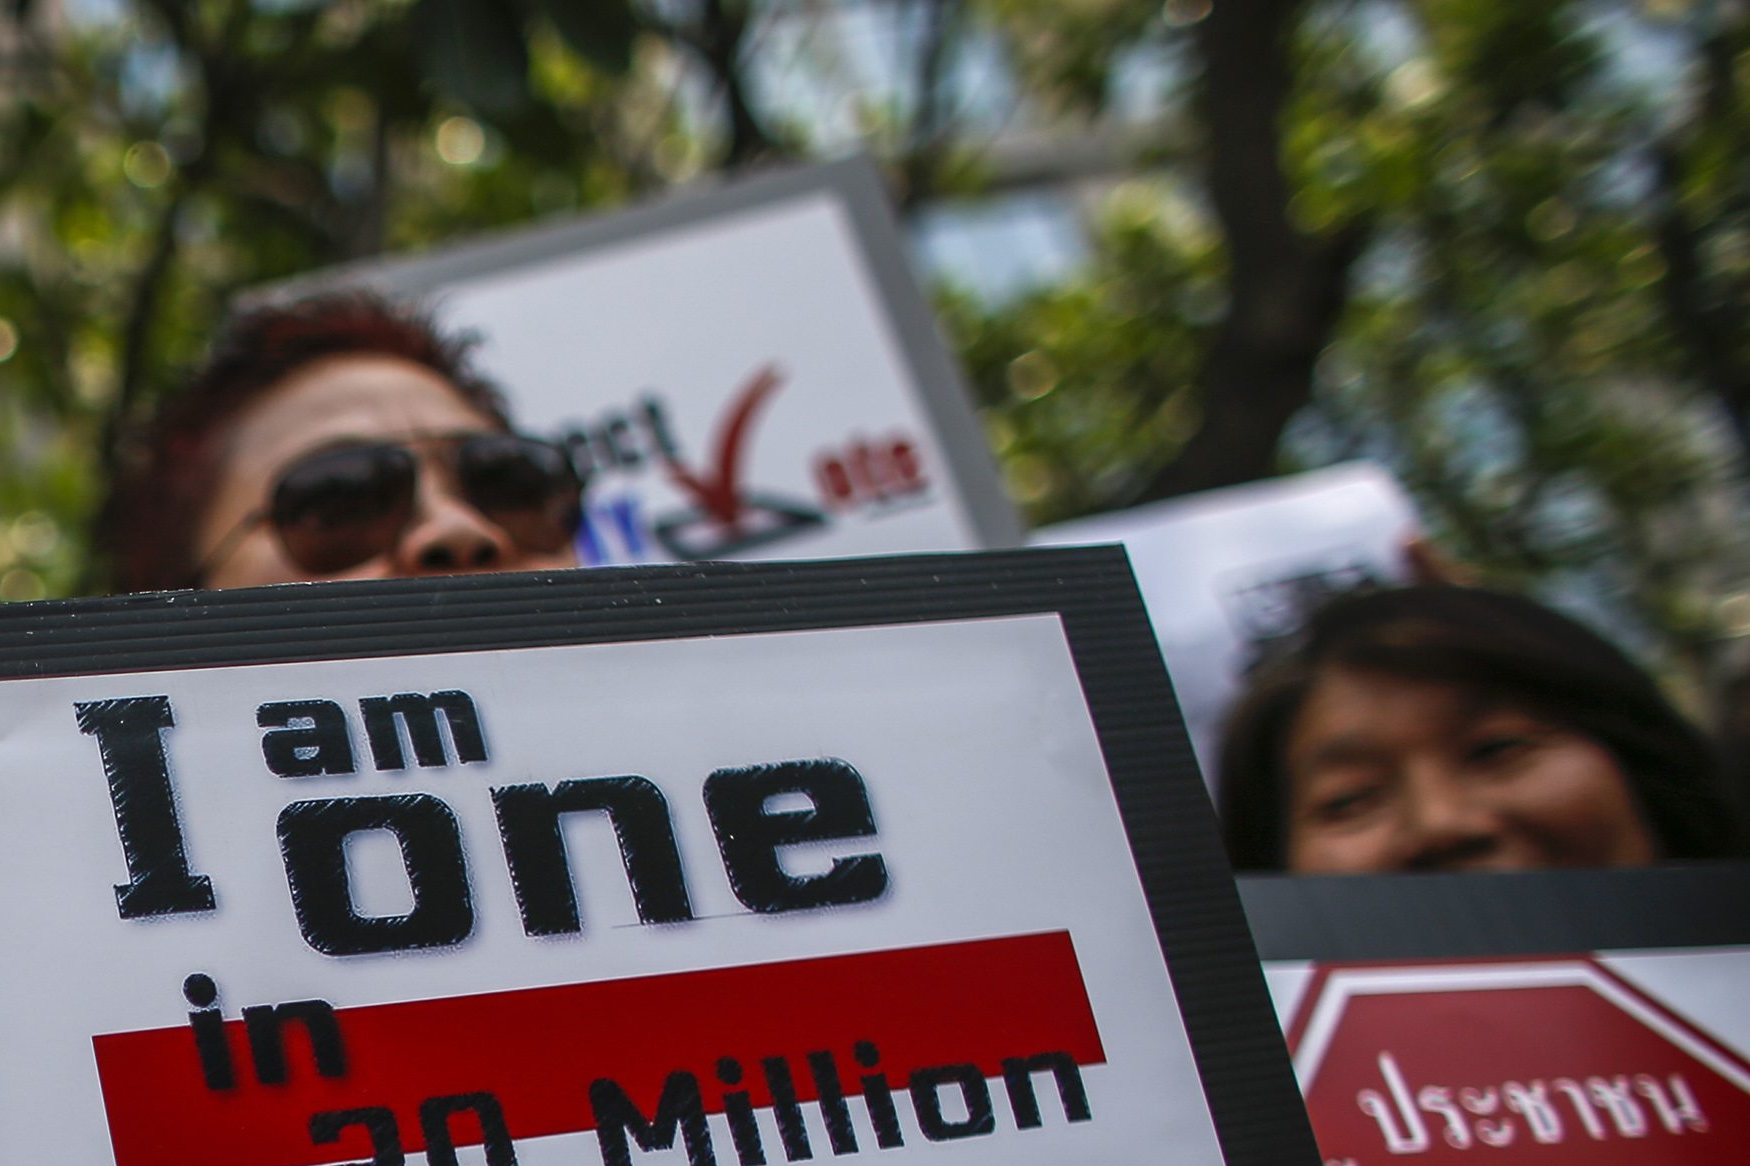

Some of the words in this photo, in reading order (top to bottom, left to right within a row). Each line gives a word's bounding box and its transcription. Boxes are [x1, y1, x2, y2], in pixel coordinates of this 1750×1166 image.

[74, 694, 218, 921] I
[255, 688, 490, 779] am
[276, 757, 891, 958] one
[182, 973, 348, 1092] in
[1356, 1050, 1709, 1155] ประชาชน
